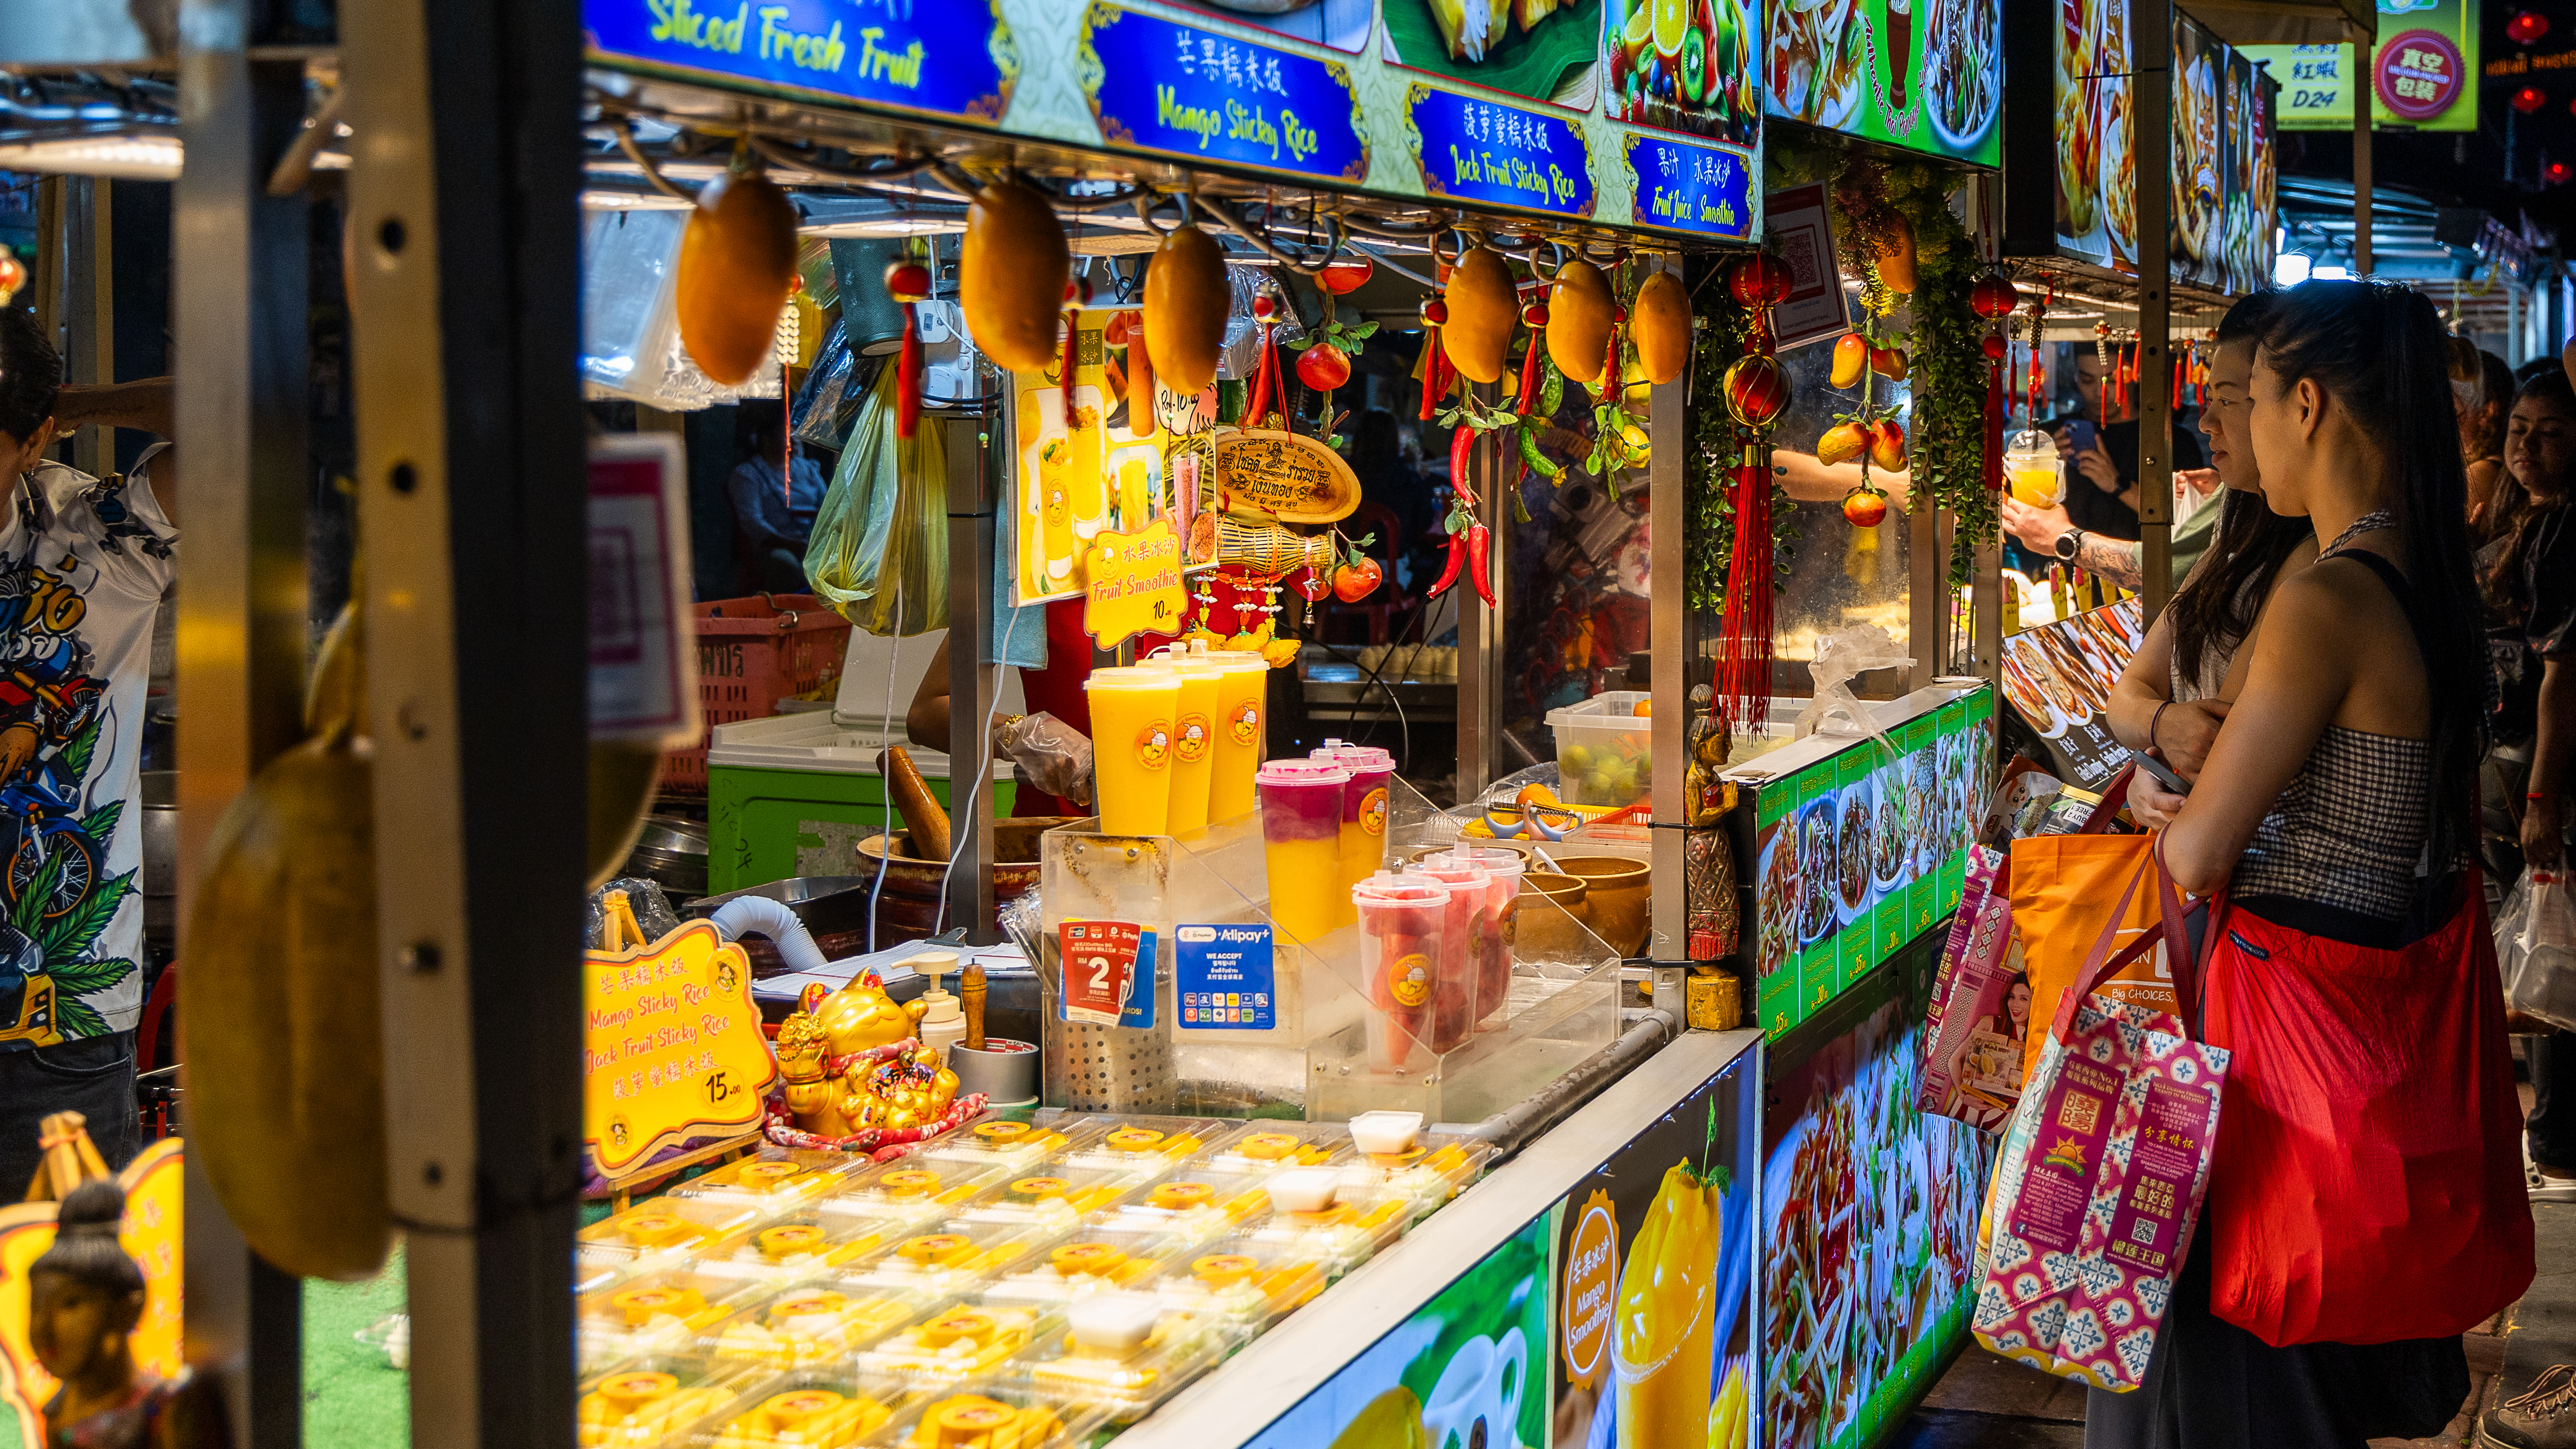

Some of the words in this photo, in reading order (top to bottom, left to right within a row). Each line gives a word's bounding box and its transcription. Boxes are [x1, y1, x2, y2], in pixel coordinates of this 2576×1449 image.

[650, 0, 748, 54] Sliced
[759, 5, 846, 73] Fresh
[860, 25, 925, 89] Fruit
[1176, 29, 1289, 97] 芒果糯米饭
[1864, 15, 1884, 115] Authentic
[1884, 100, 1897, 137] Thai
[1899, 96, 1920, 144] Papaya
[1918, 29, 1930, 99] Salad
[2292, 90, 2338, 108] D24
[1157, 83, 1221, 149] Mango
[1225, 98, 1279, 161] Sticky
[1281, 109, 1318, 163] Rice
[1450, 144, 1483, 187] Jack
[1481, 151, 1511, 187] Fruit
[1511, 159, 1549, 206] Sticky
[1549, 164, 1576, 206] Rice
[1657, 146, 1680, 180] 果汁
[1693, 154, 1731, 189] 水果冰沙
[1652, 185, 1673, 216] Fruit
[1670, 188, 1692, 223] Juice
[1699, 196, 1735, 227] Smoothie
[1081, 331, 1098, 345] 水果
[1081, 348, 1098, 363] 冰沙
[1236, 448, 1262, 473] โชคดี
[1122, 537, 1175, 563] 水果冰沙
[1092, 578, 1124, 603] Fruit
[1127, 567, 1177, 596] Smoothie
[1220, 928, 1270, 943] Alipay+
[600, 956, 690, 995] 芒果糯米饭
[1088, 956, 1110, 990] 2
[589, 1007, 634, 1032] Mango
[637, 991, 678, 1017] Sticky
[682, 983, 710, 1006] Rice
[1122, 1006, 1142, 1015] ARDS!
[2112, 988, 2125, 1000] Big
[2129, 989, 2174, 1003] CHOICES,
[586, 1044, 618, 1075] Jack
[622, 1032, 655, 1060] Fruit
[657, 1021, 698, 1046] Sticky
[701, 1014, 730, 1038] Rice
[613, 1051, 720, 1101] 菠萝蜜糯米饭
[706, 1072, 741, 1103] 15.00
[2134, 1185, 2175, 1209] 最好的
[1576, 1280, 1605, 1316] Mango
[1570, 1301, 1610, 1348] Smoothie
